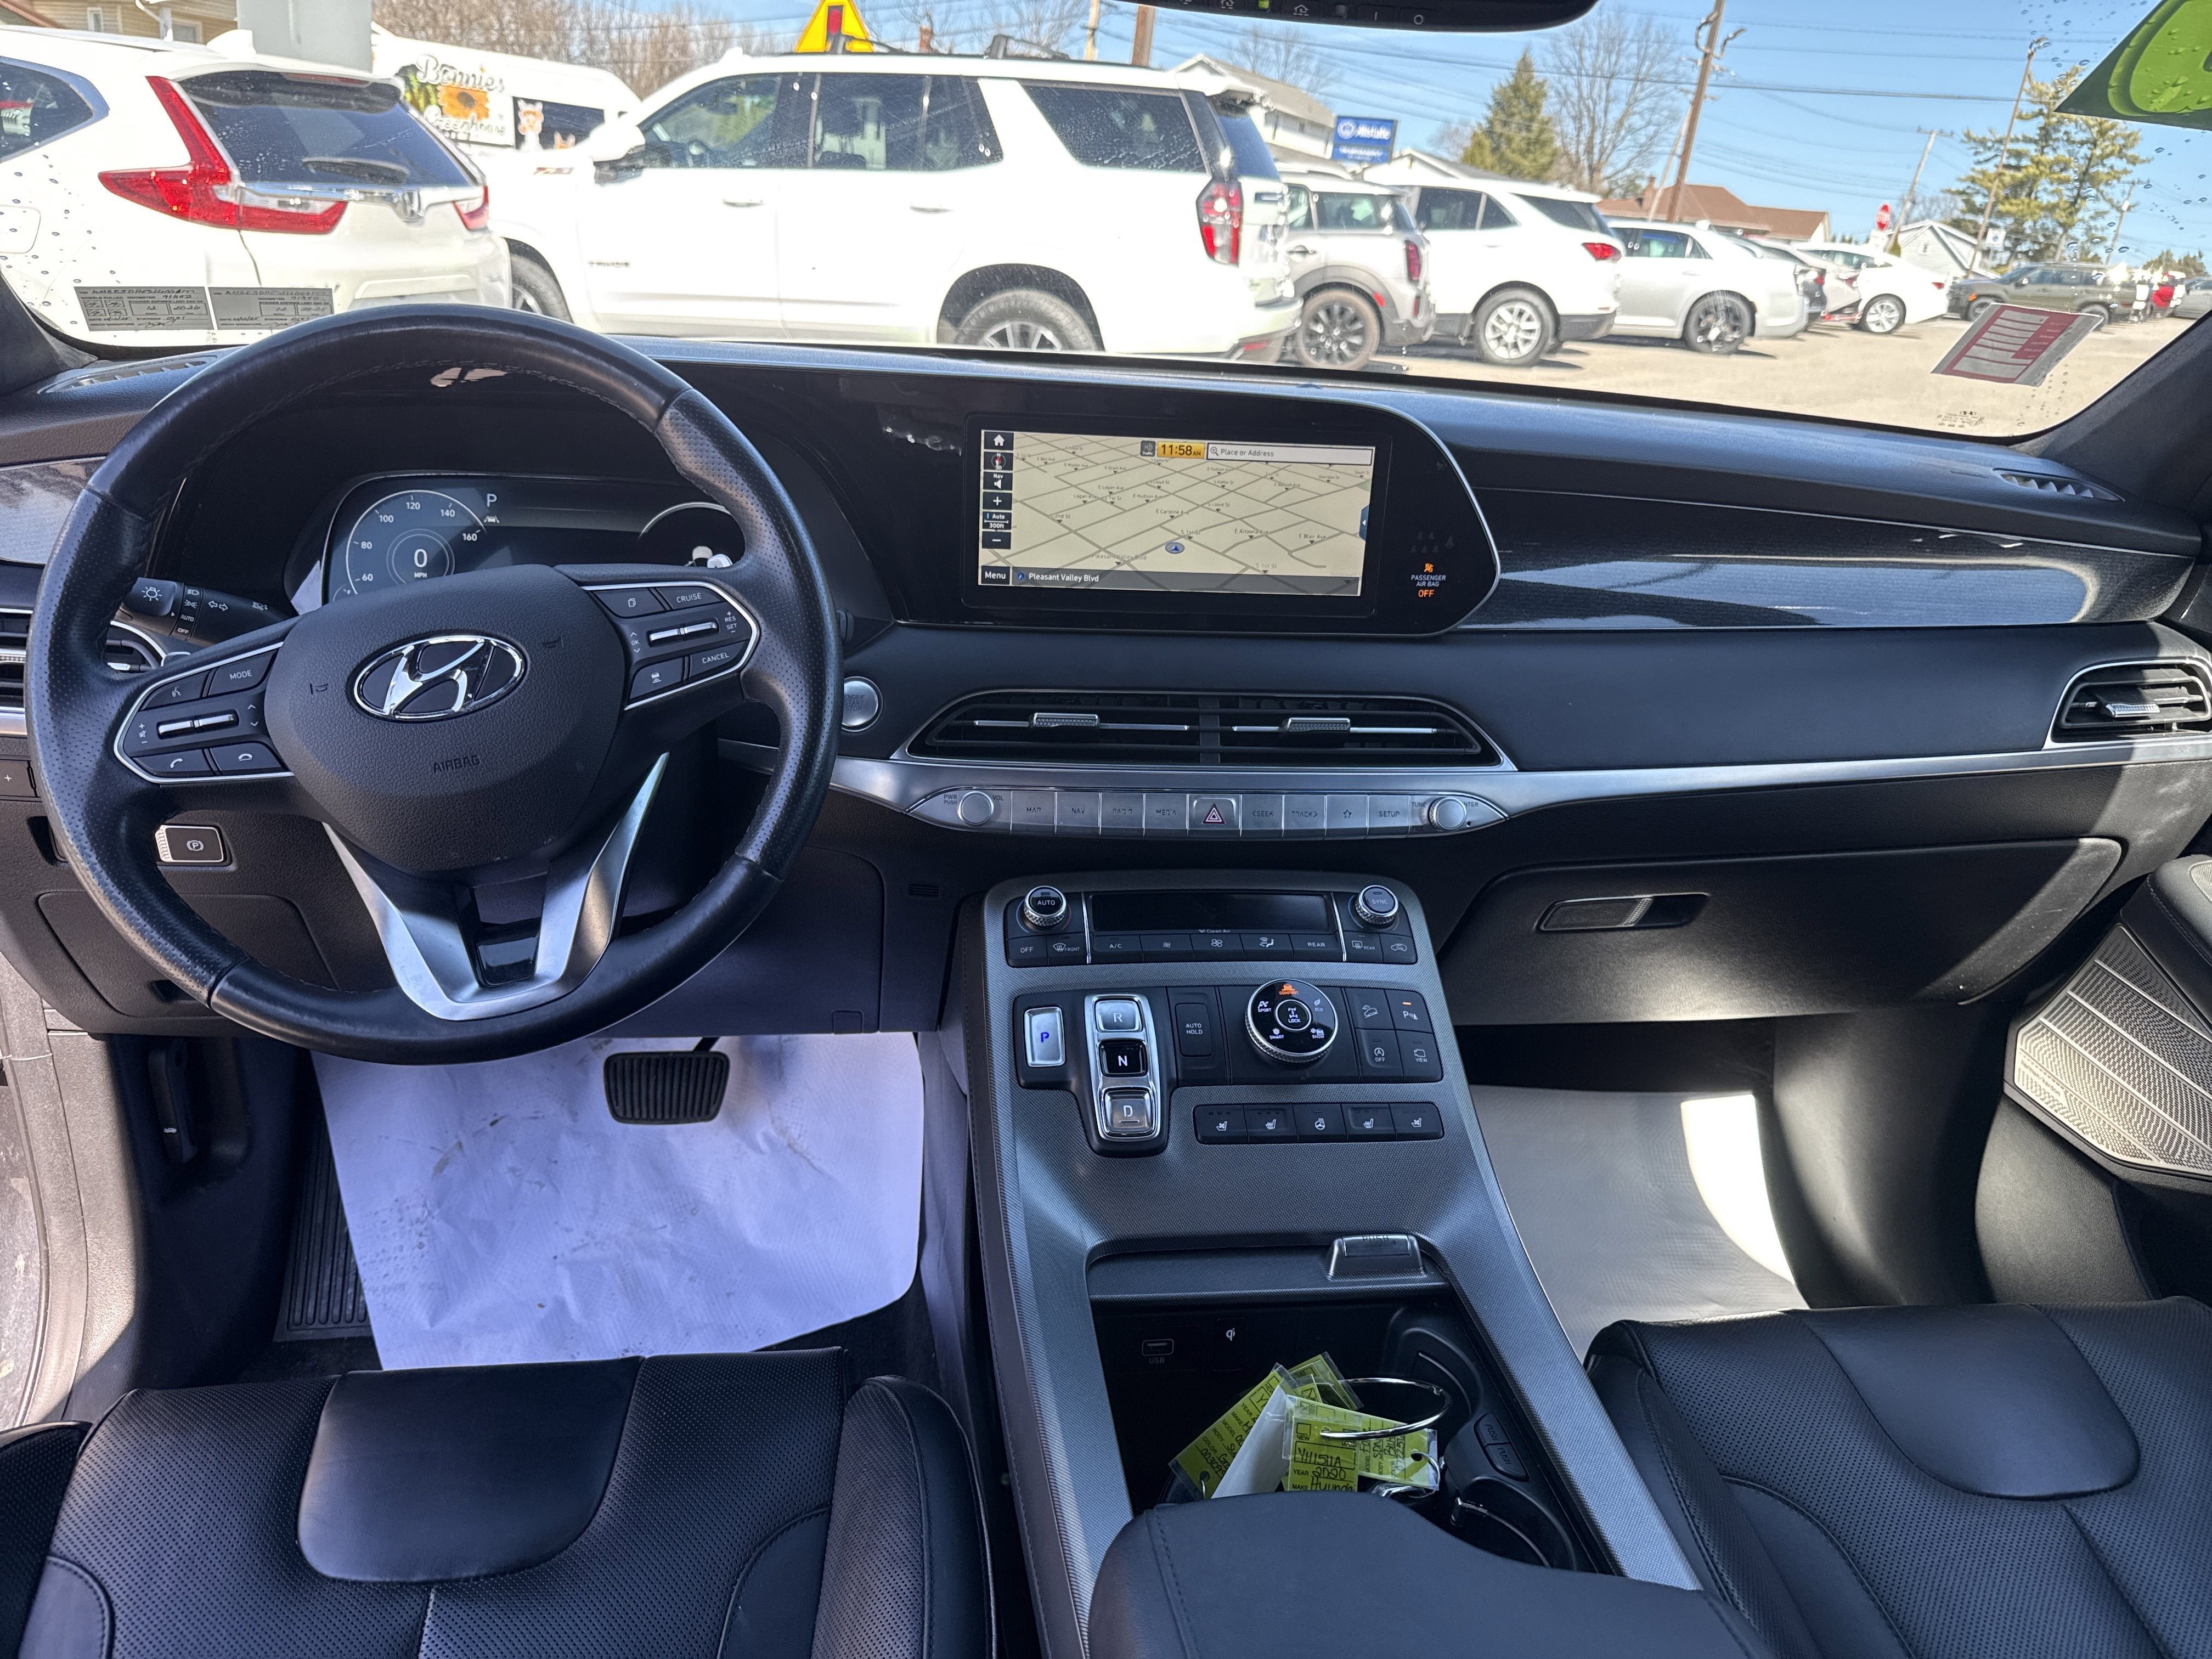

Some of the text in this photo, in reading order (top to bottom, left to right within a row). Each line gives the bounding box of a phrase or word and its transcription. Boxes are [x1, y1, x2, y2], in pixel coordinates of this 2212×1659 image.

[1161, 444, 1193, 456] 11:58
[407, 502, 421, 510] 120
[487, 494, 497, 507] P
[379, 515, 394, 523] 100
[441, 510, 455, 518] 140
[462, 533, 477, 541] 160
[414, 548, 428, 568] 0
[362, 573, 374, 582] 60
[985, 571, 1006, 579] Menu
[1029, 573, 1059, 581] Pleasant
[1060, 574, 1082, 583] Valley
[676, 592, 702, 603] CRUISE
[1418, 589, 1435, 597] OFF
[179, 614, 195, 623] AUTO
[702, 652, 730, 664] CANCEL
[229, 669, 253, 681] MODE
[432, 754, 481, 774] AIRBAG
[1113, 1012, 1123, 1023] R
[1040, 1031, 1050, 1043] P
[1118, 1055, 1128, 1067] N
[1123, 1105, 1133, 1118] D
[1241, 1402, 1253, 1418] YEAR
[1231, 1410, 1244, 1427] MAKE
[1211, 1427, 1225, 1442] BODY
[1221, 1419, 1235, 1438] MODEL
[1203, 1436, 1218, 1454] COLOR
